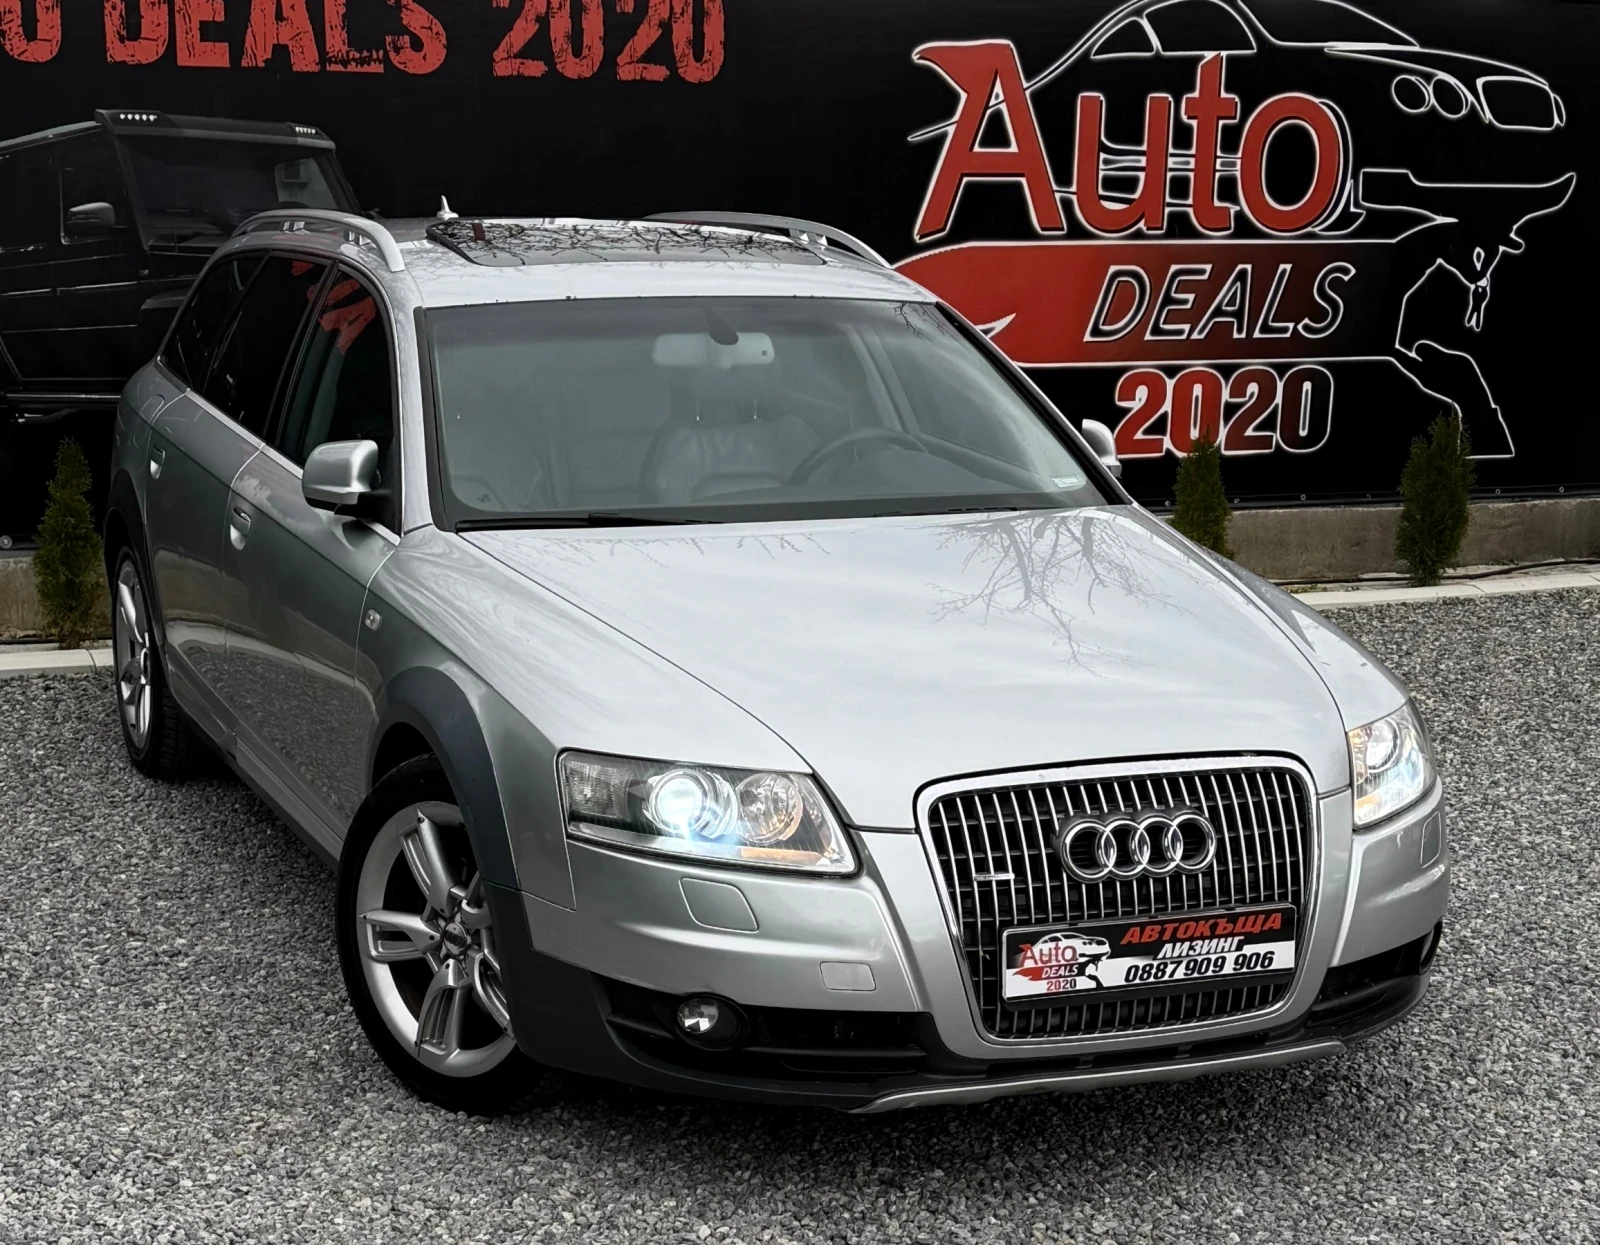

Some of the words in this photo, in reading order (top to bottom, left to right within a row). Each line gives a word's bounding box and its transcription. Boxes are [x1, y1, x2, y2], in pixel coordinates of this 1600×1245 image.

[104, 0, 447, 74] DEALS
[493, 0, 725, 83] 2020
[912, 40, 1350, 240] Auto
[1083, 261, 1356, 342] DEALS
[1114, 365, 1334, 457] 2020
[1120, 912, 1282, 945] АВТОКЪЩА
[1019, 942, 1078, 968] Auto
[1156, 935, 1245, 959] ЛИЗИНГ
[1232, 951, 1275, 972] 906
[1041, 964, 1079, 978] DEALS
[1046, 978, 1077, 991] 2020
